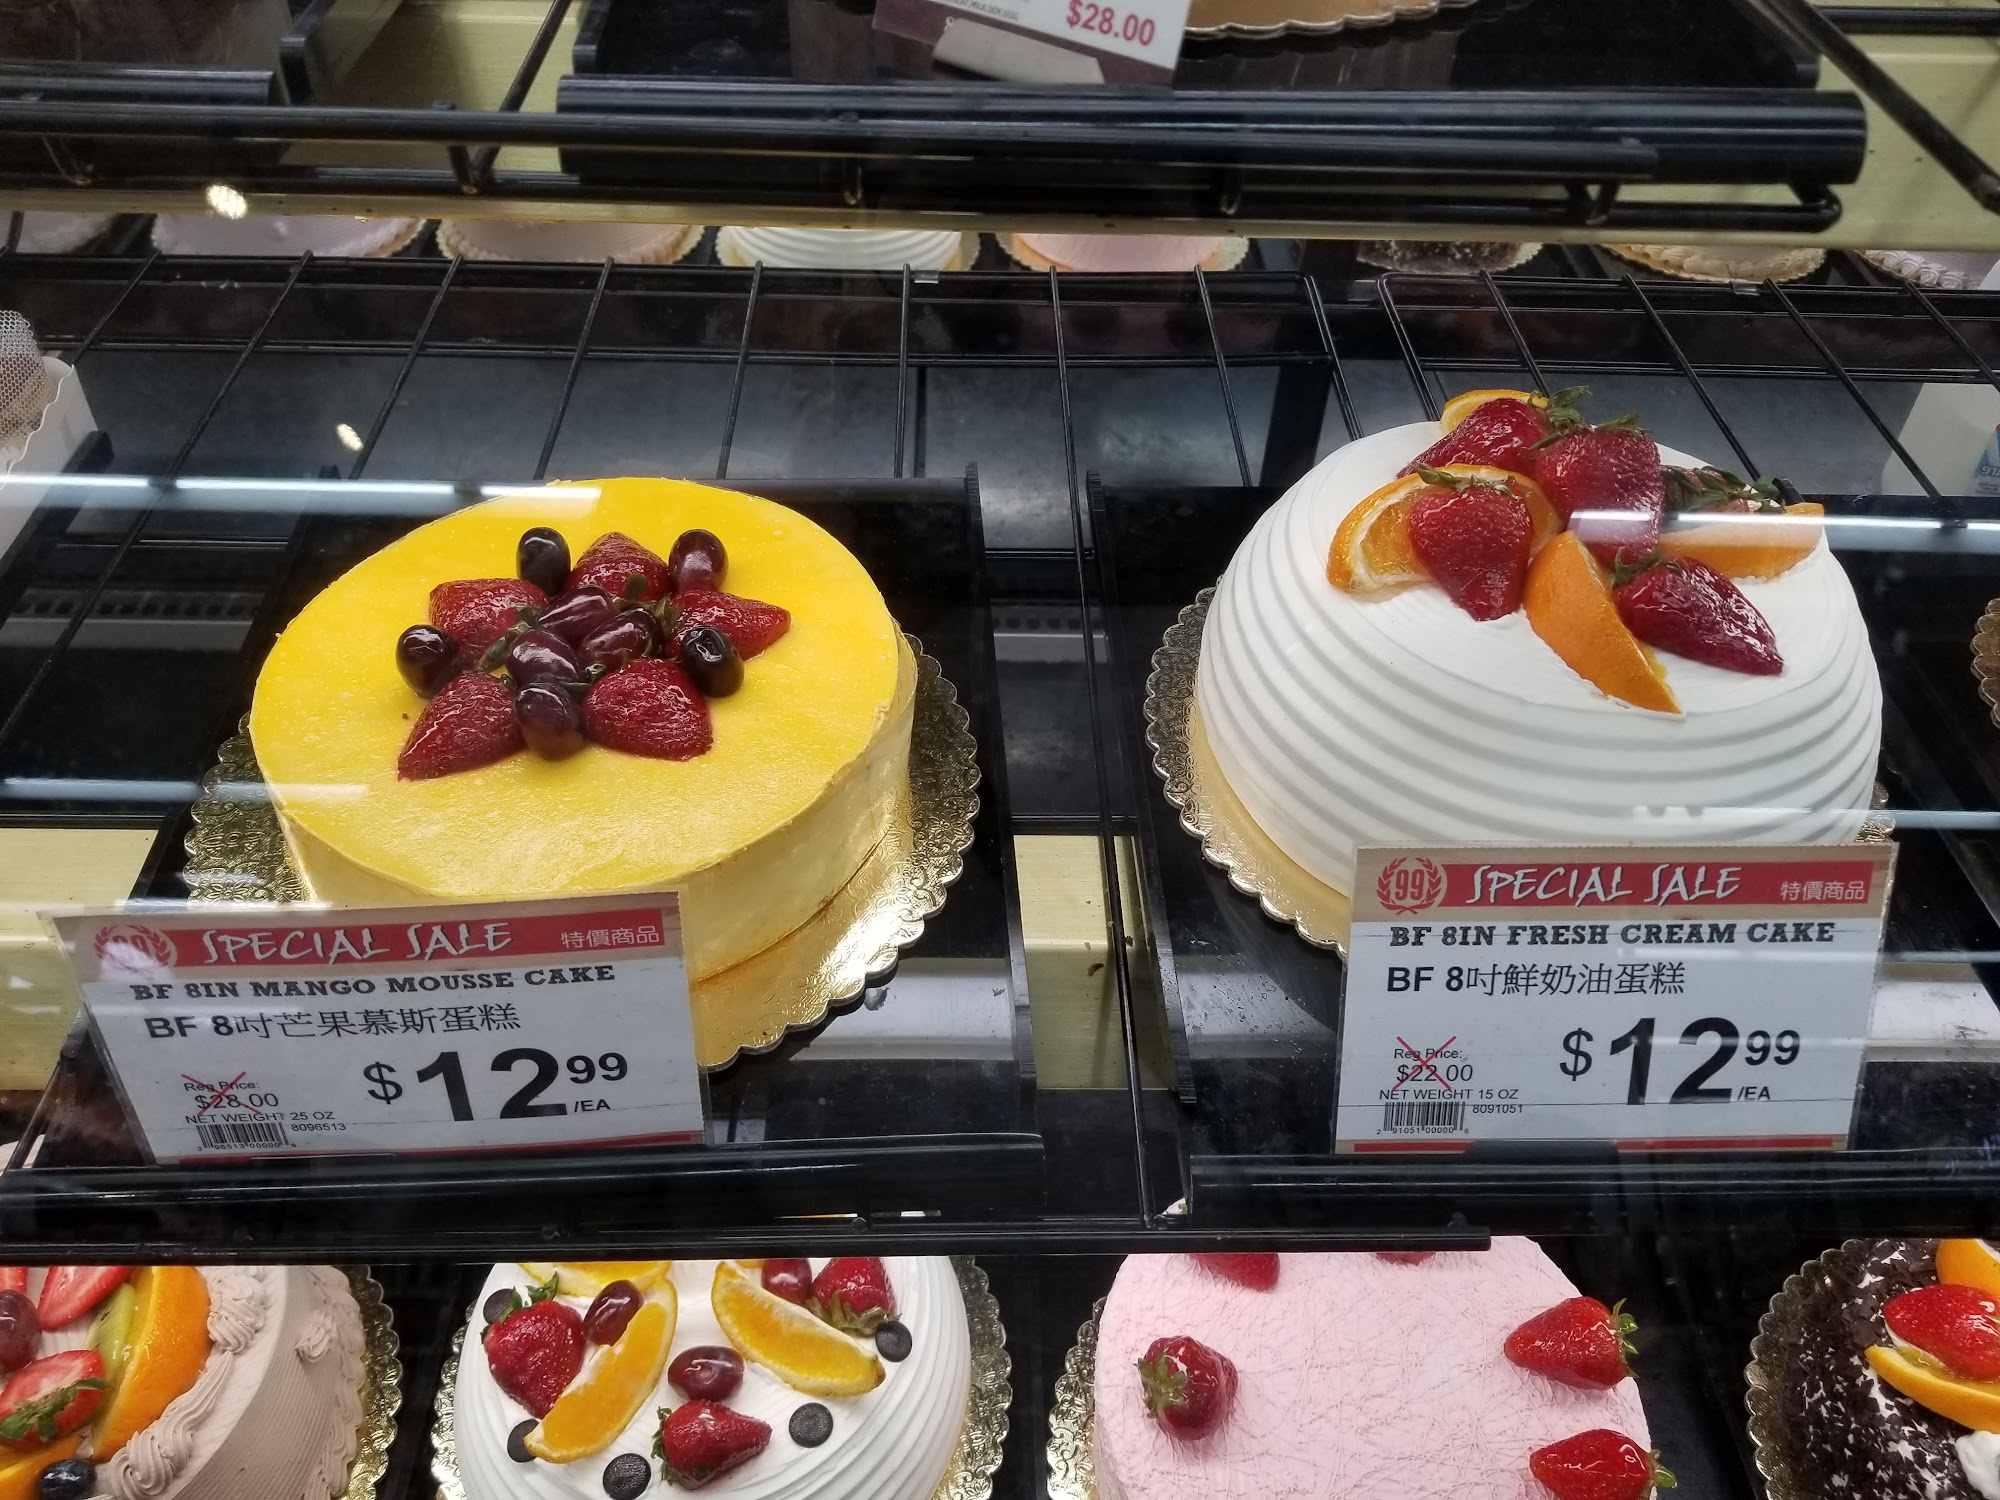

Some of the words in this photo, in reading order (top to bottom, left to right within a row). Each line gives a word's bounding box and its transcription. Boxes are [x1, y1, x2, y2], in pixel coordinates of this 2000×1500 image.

[1066, 0, 1155, 46] $28.00
[1394, 868, 1426, 900] 99
[1466, 865, 1633, 907] SPECIAL
[1644, 863, 1743, 907] SALE
[1780, 880, 1865, 901] 特價商品
[202, 928, 390, 966] SPECIAL
[406, 922, 513, 961] SALE
[561, 925, 659, 948] 特價商品
[1390, 926, 1432, 947] BF
[1441, 925, 1496, 946] 8IN
[1506, 924, 1610, 945] FRESH
[1620, 923, 1737, 944] CREAM
[1746, 922, 1835, 943] CAKE
[130, 983, 173, 1000] BF
[184, 981, 239, 998] 8IN
[249, 977, 376, 998] MANGO
[385, 972, 514, 993] MOUSSE
[524, 965, 615, 988] CAKE
[1386, 966, 1434, 992] BF
[144, 1015, 197, 1039] BF
[1394, 1048, 1420, 1061] Reg
[1425, 1048, 1463, 1059] Price:
[183, 1081, 215, 1093] Reg
[1379, 1089, 1410, 1100] NET
[1414, 1089, 1473, 1100] WEIGHT
[1478, 1089, 1494, 1100] 15
[1498, 1089, 1518, 1100] OZ
[185, 1114, 216, 1125] NET
[221, 1112, 285, 1123] WEIGHT
[290, 1112, 309, 1121] 25
[313, 1111, 335, 1121] OZ
[1472, 1104, 1523, 1114] 8091051
[291, 1123, 346, 1132] 8096513
